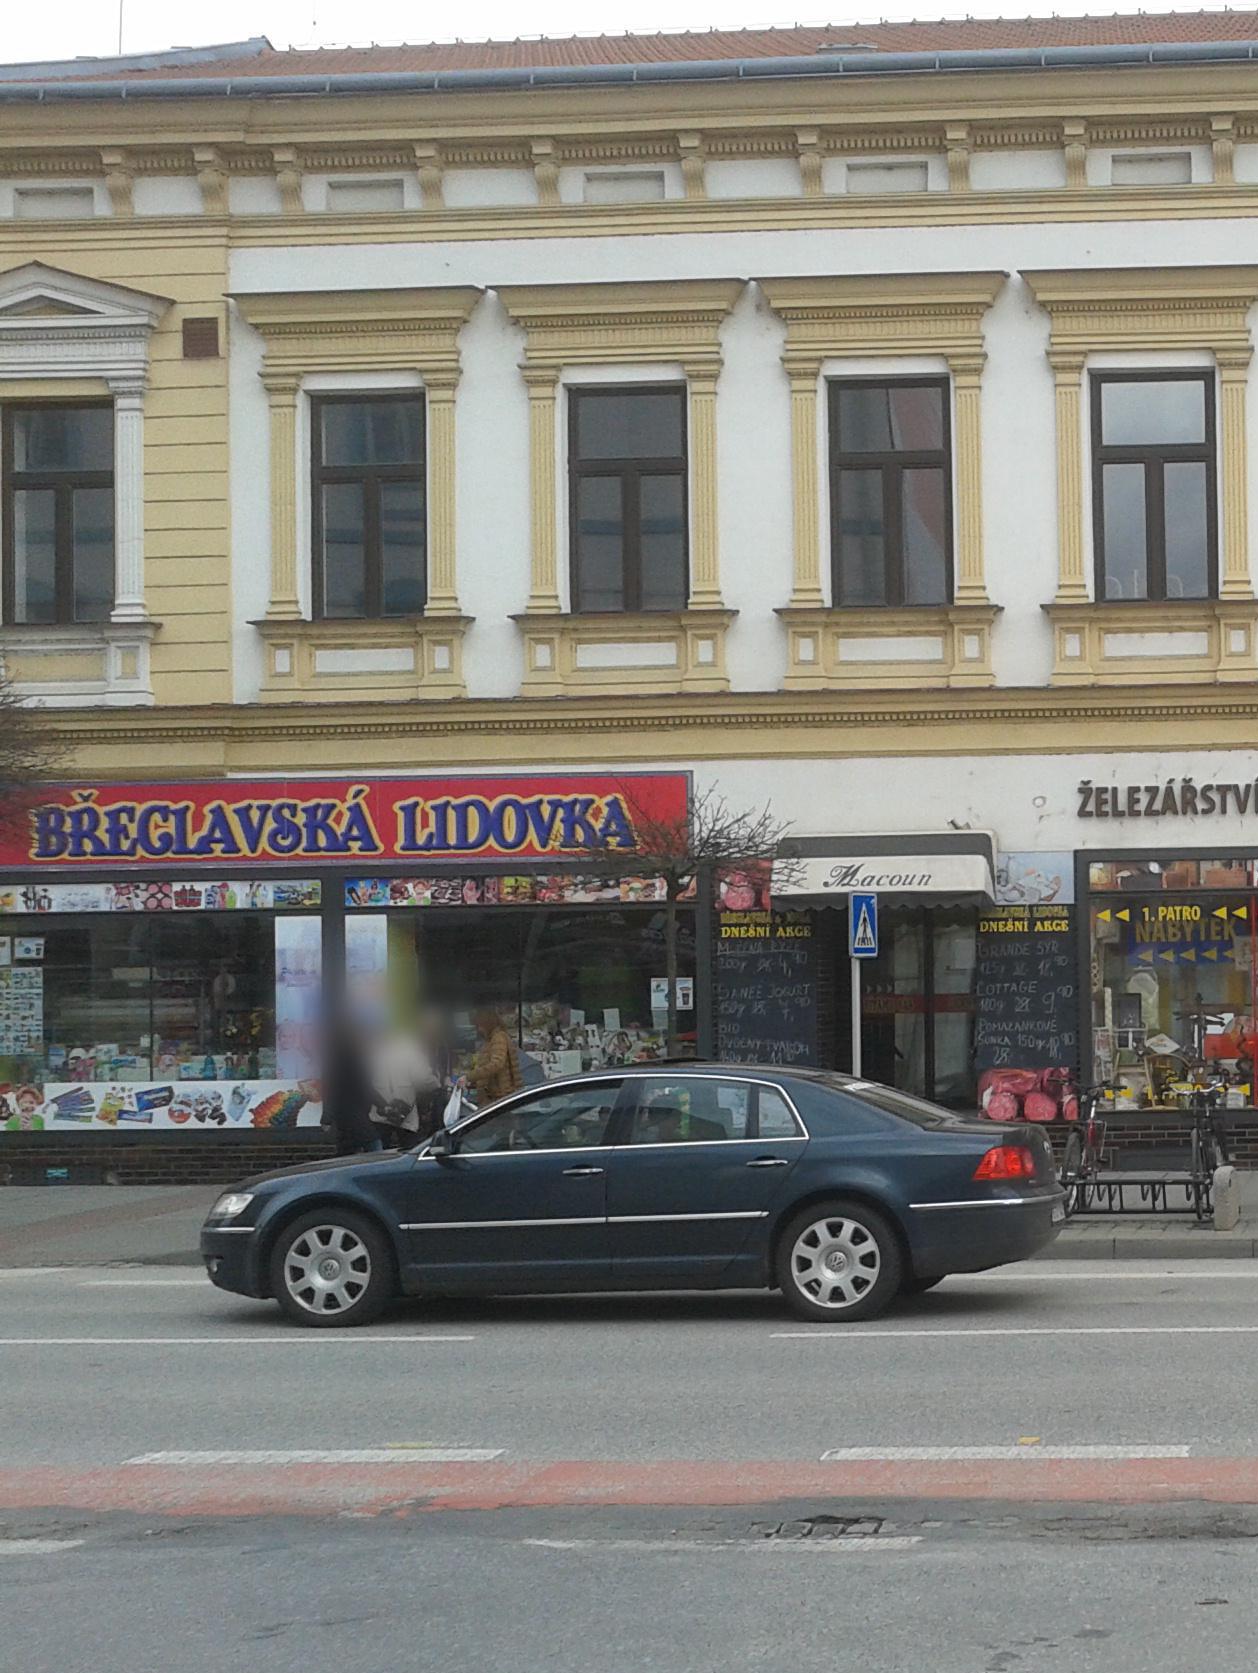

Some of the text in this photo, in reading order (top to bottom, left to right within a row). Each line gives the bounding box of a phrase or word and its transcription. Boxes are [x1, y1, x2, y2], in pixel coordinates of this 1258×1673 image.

[33, 787, 640, 860] BŘECLAVSKÁ LIDOVKA
[822, 864, 933, 888] Macoun
[1158, 905, 1202, 921] PATRO
[720, 924, 812, 938] DNEŠNÍ AKCE
[979, 918, 1070, 933] DNEŠNÍ AKCE
